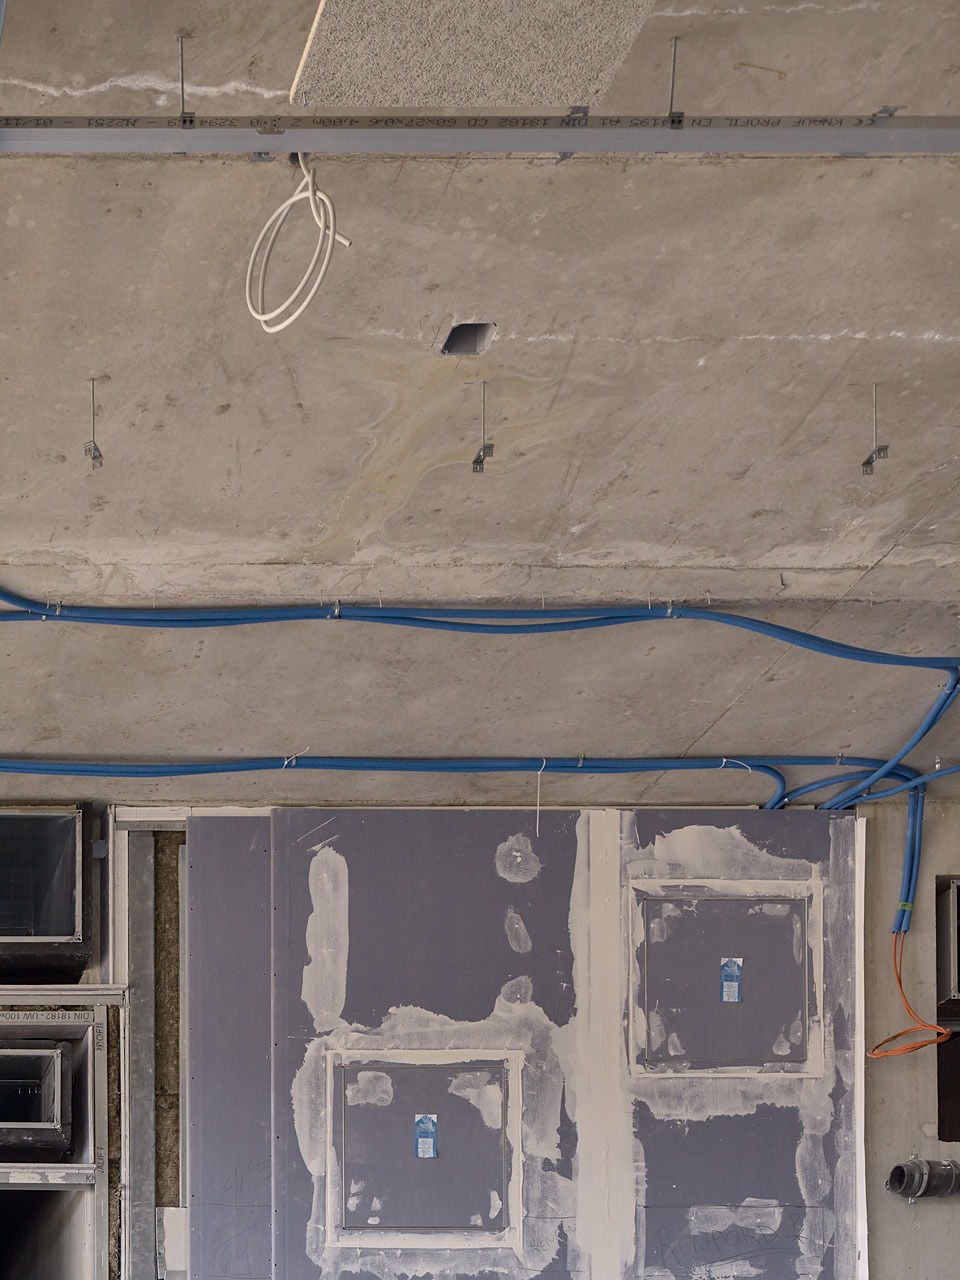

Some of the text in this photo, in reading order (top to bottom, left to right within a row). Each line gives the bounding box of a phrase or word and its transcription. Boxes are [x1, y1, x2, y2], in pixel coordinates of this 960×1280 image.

[497, 118, 549, 127] 18182
[560, 118, 588, 127] DIN
[630, 118, 680, 127] 4195
[691, 118, 712, 127] EN
[724, 118, 781, 127] PROFIL
[792, 118, 843, 127] KNAUF
[45, 1012, 71, 1020] 18182
[74, 1012, 90, 1020] DIN
